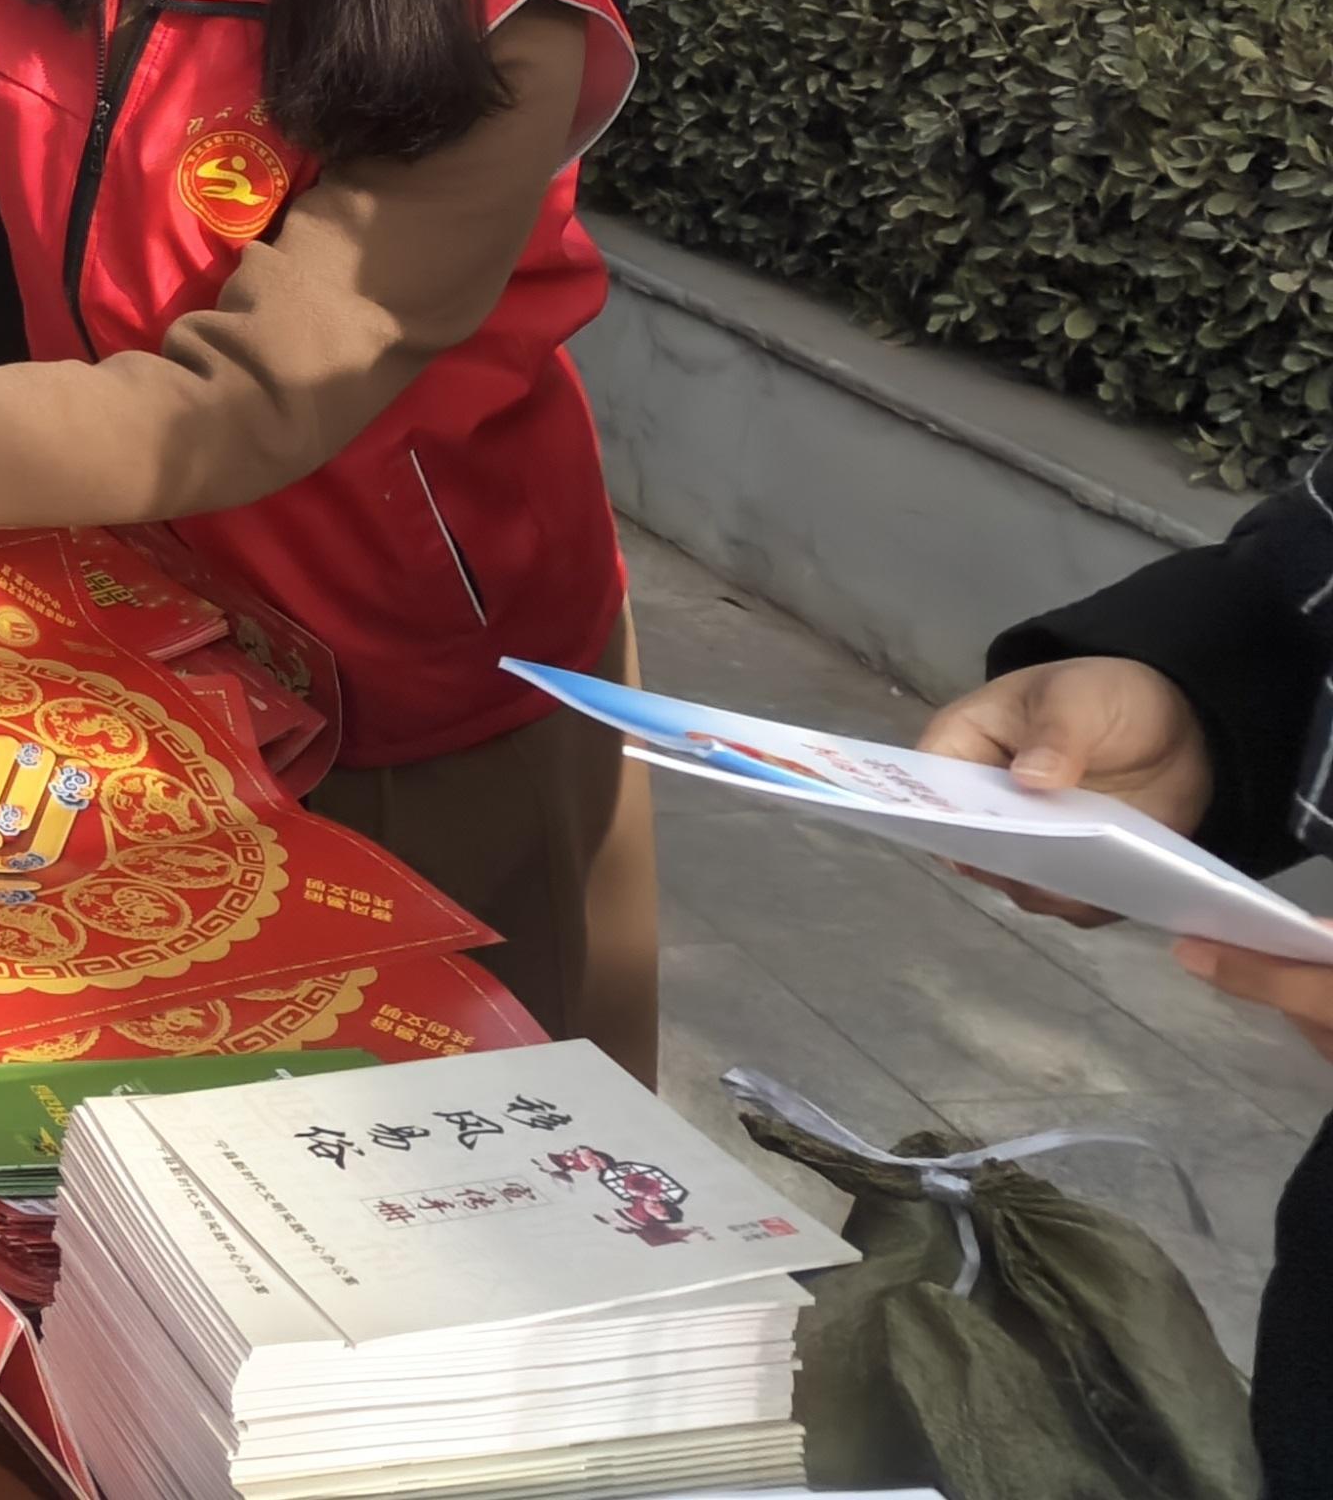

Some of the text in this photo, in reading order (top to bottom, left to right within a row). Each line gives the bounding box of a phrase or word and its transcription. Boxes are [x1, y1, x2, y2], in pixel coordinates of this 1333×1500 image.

[303, 890, 393, 923] 移风易俗
[305, 878, 393, 909] 共创文明
[369, 1015, 465, 1055] 移风易俗
[378, 1003, 475, 1047] 共创文明
[293, 1093, 573, 1172] 移风易俗
[213, 1139, 363, 1288] 宁县新时代文明实践中心办公室
[371, 1180, 541, 1229] 宣传手册
